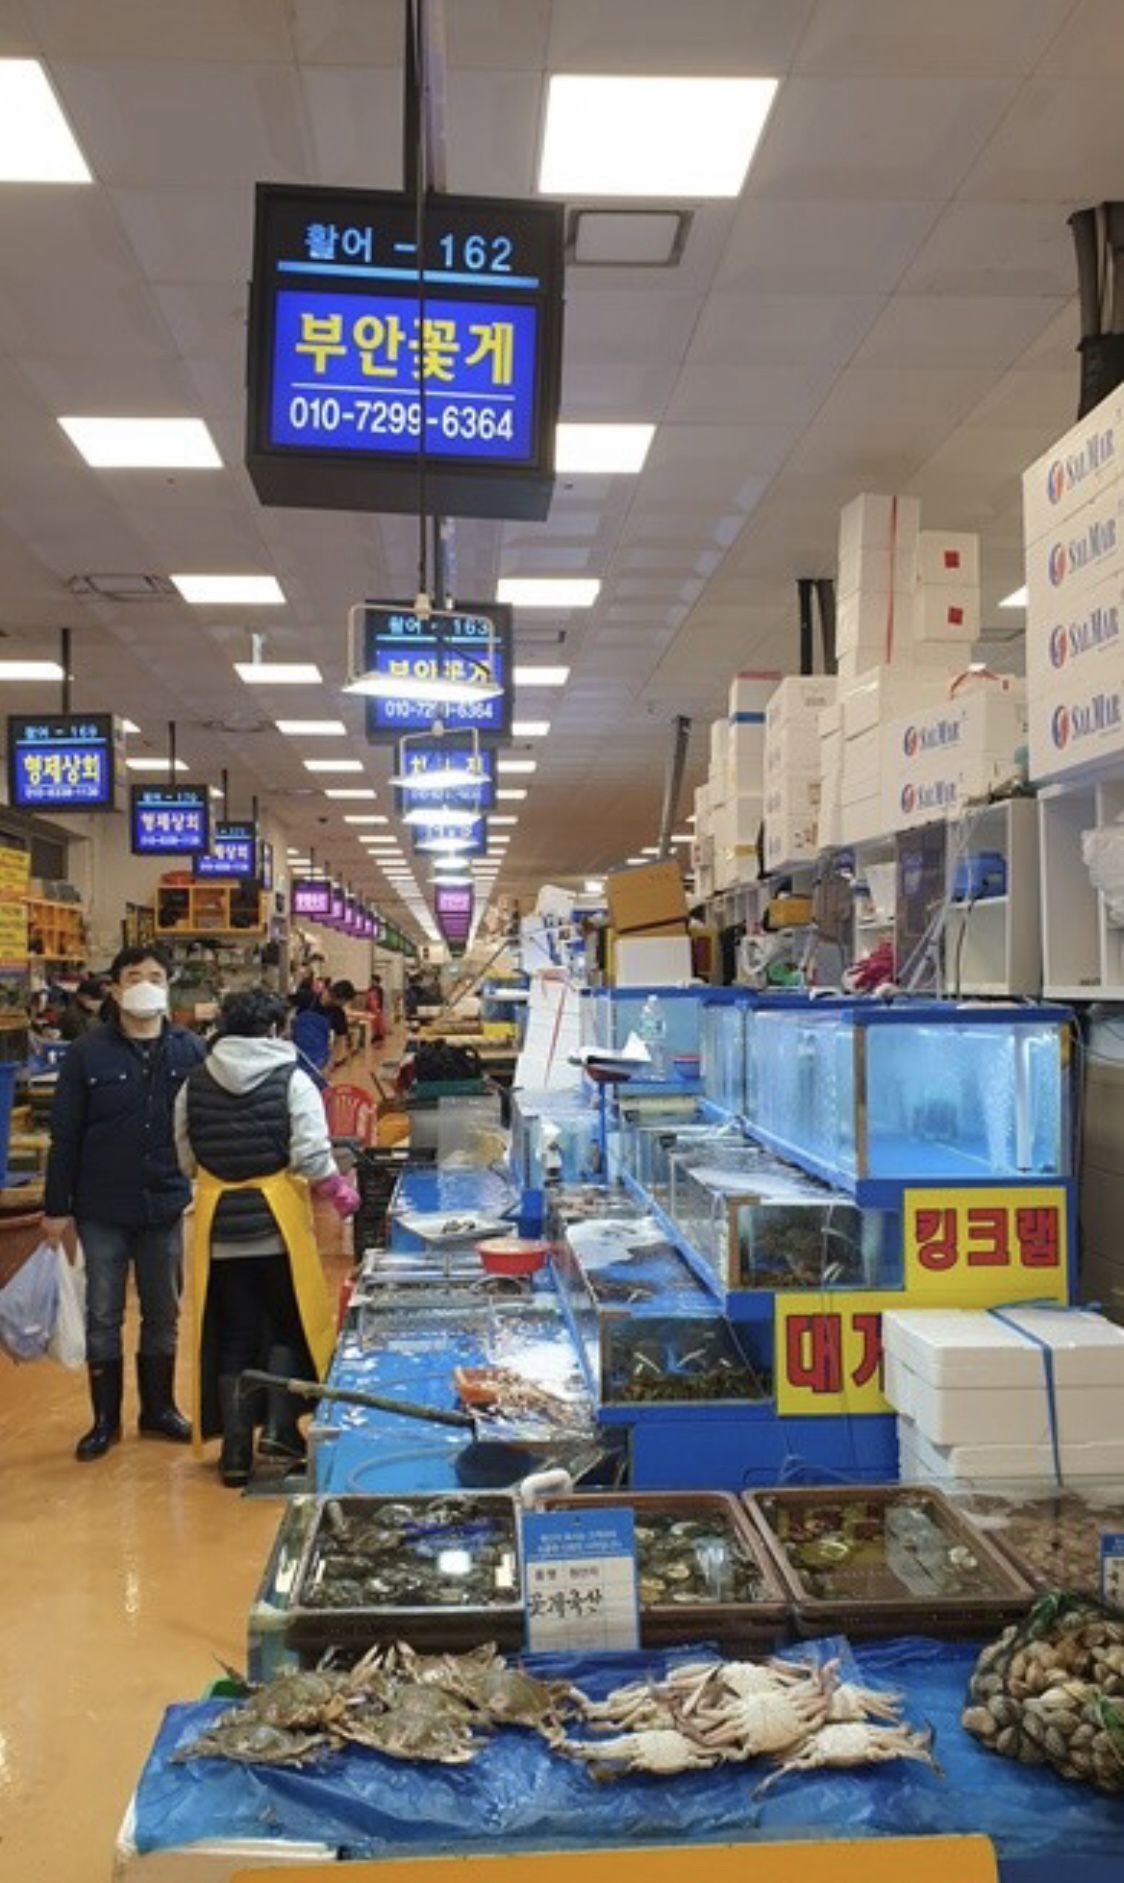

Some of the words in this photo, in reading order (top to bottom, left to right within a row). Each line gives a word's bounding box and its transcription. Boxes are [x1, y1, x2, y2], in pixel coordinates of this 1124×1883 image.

[305, 223, 373, 263] 활어
[440, 233, 512, 272] 162
[295, 312, 513, 386] 부안꽃게
[289, 396, 513, 441] 010-7299-6364
[454, 618, 488, 636] 163
[24, 754, 101, 785] 형제상회
[915, 1206, 1060, 1271] 킹크랩
